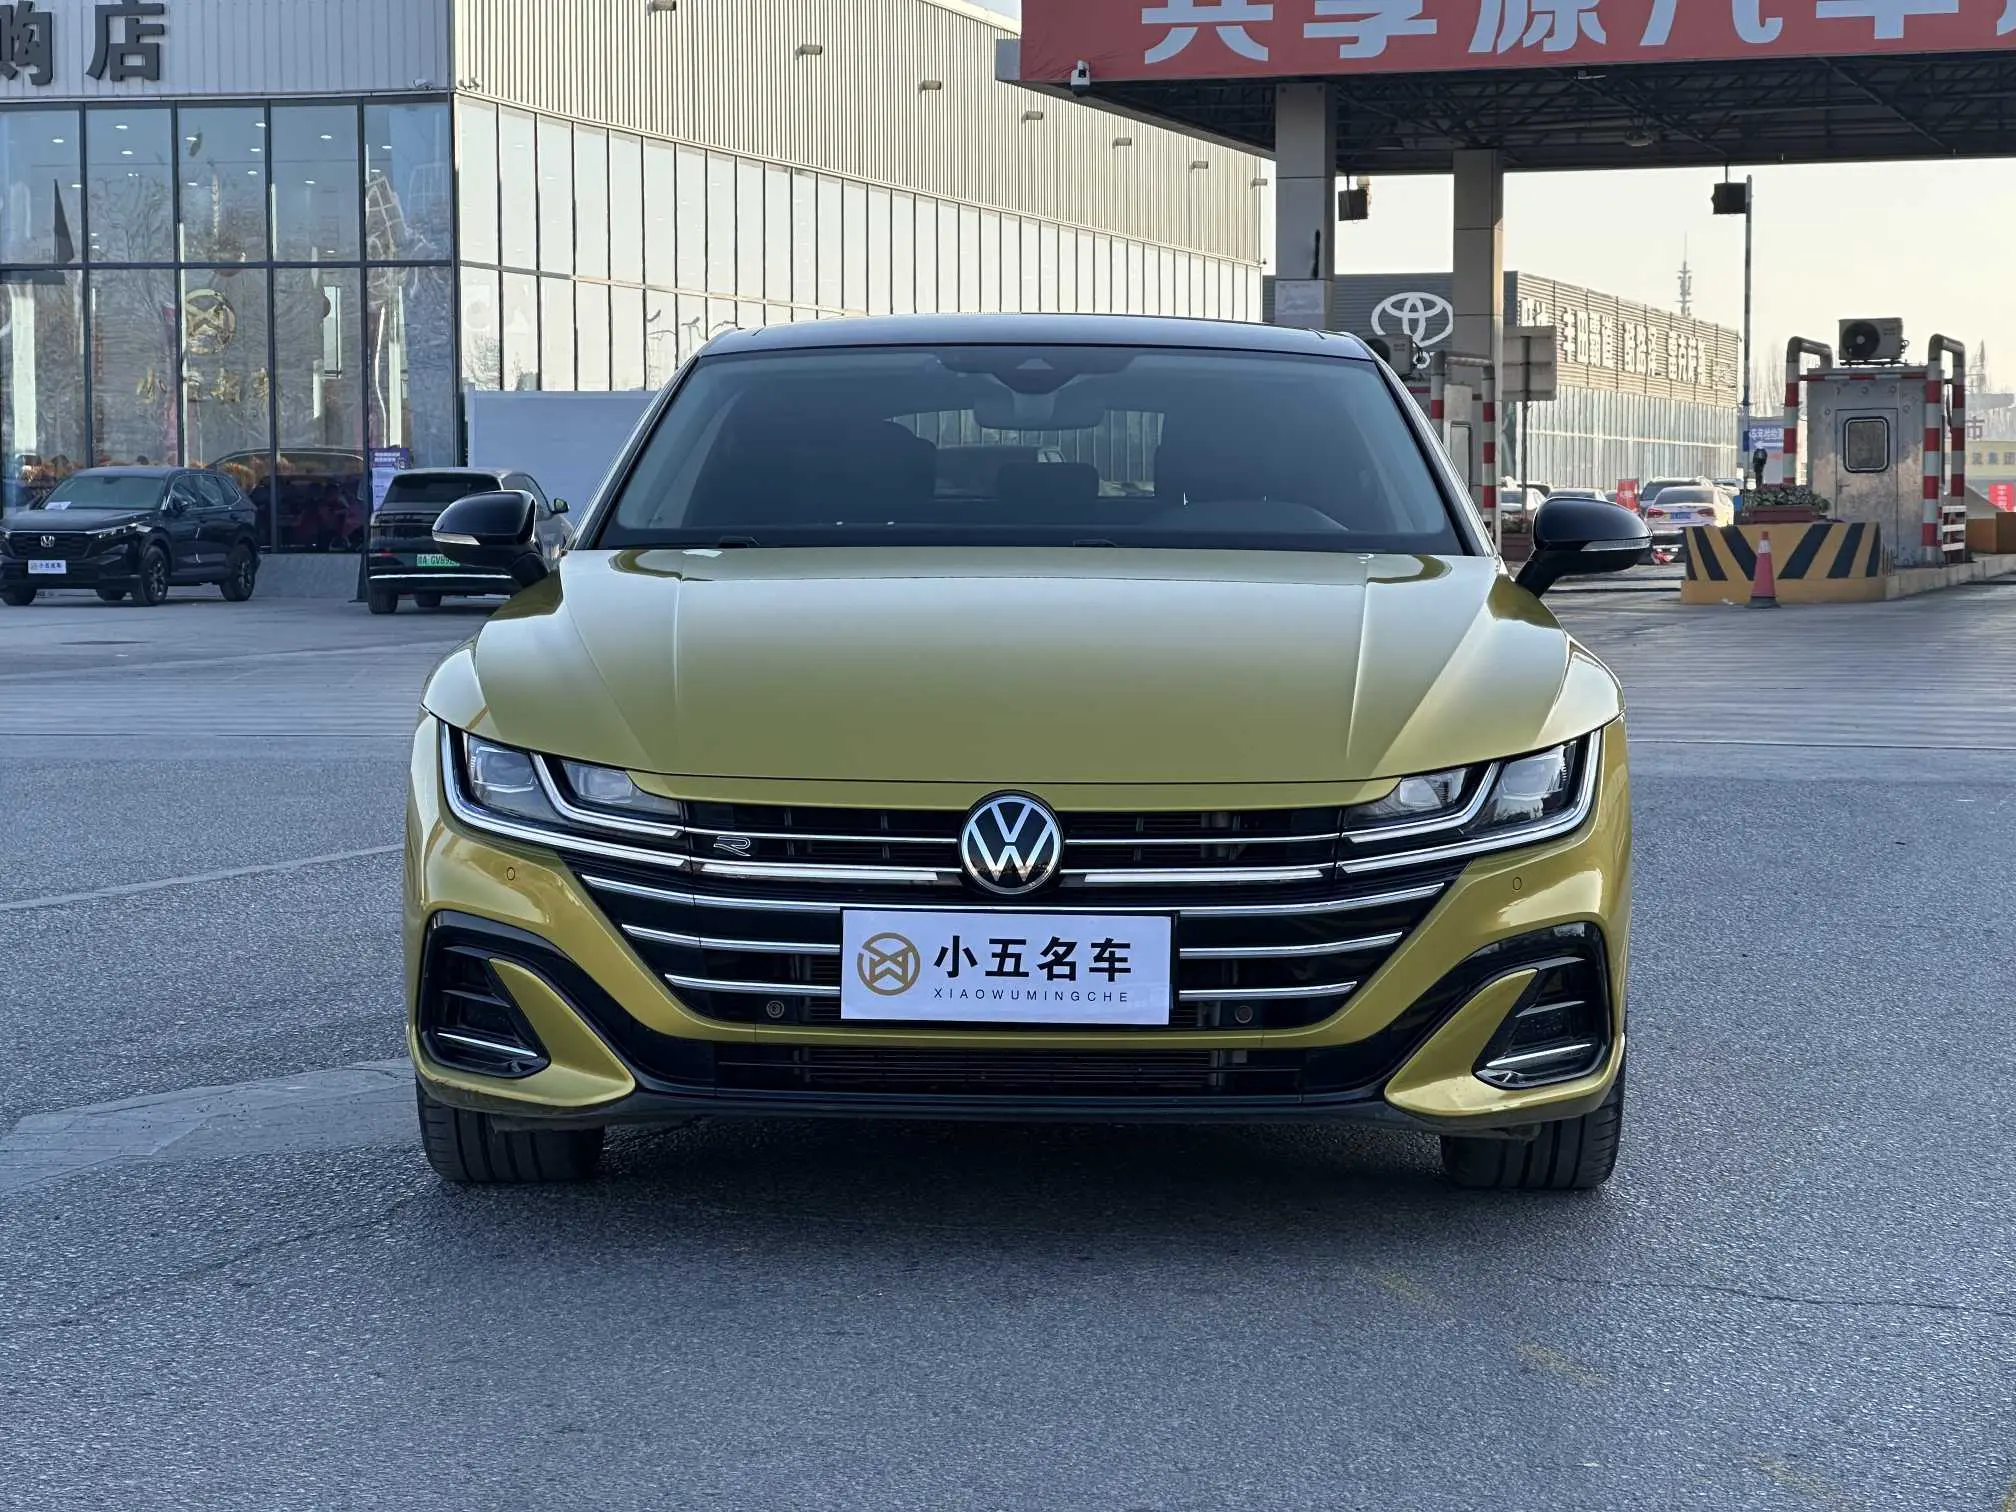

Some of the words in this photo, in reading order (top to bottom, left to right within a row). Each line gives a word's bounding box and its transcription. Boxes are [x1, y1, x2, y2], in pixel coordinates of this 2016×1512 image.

[934, 935, 1131, 982] 小五名车
[934, 987, 1129, 1002] XIAOWUMINGCHE
